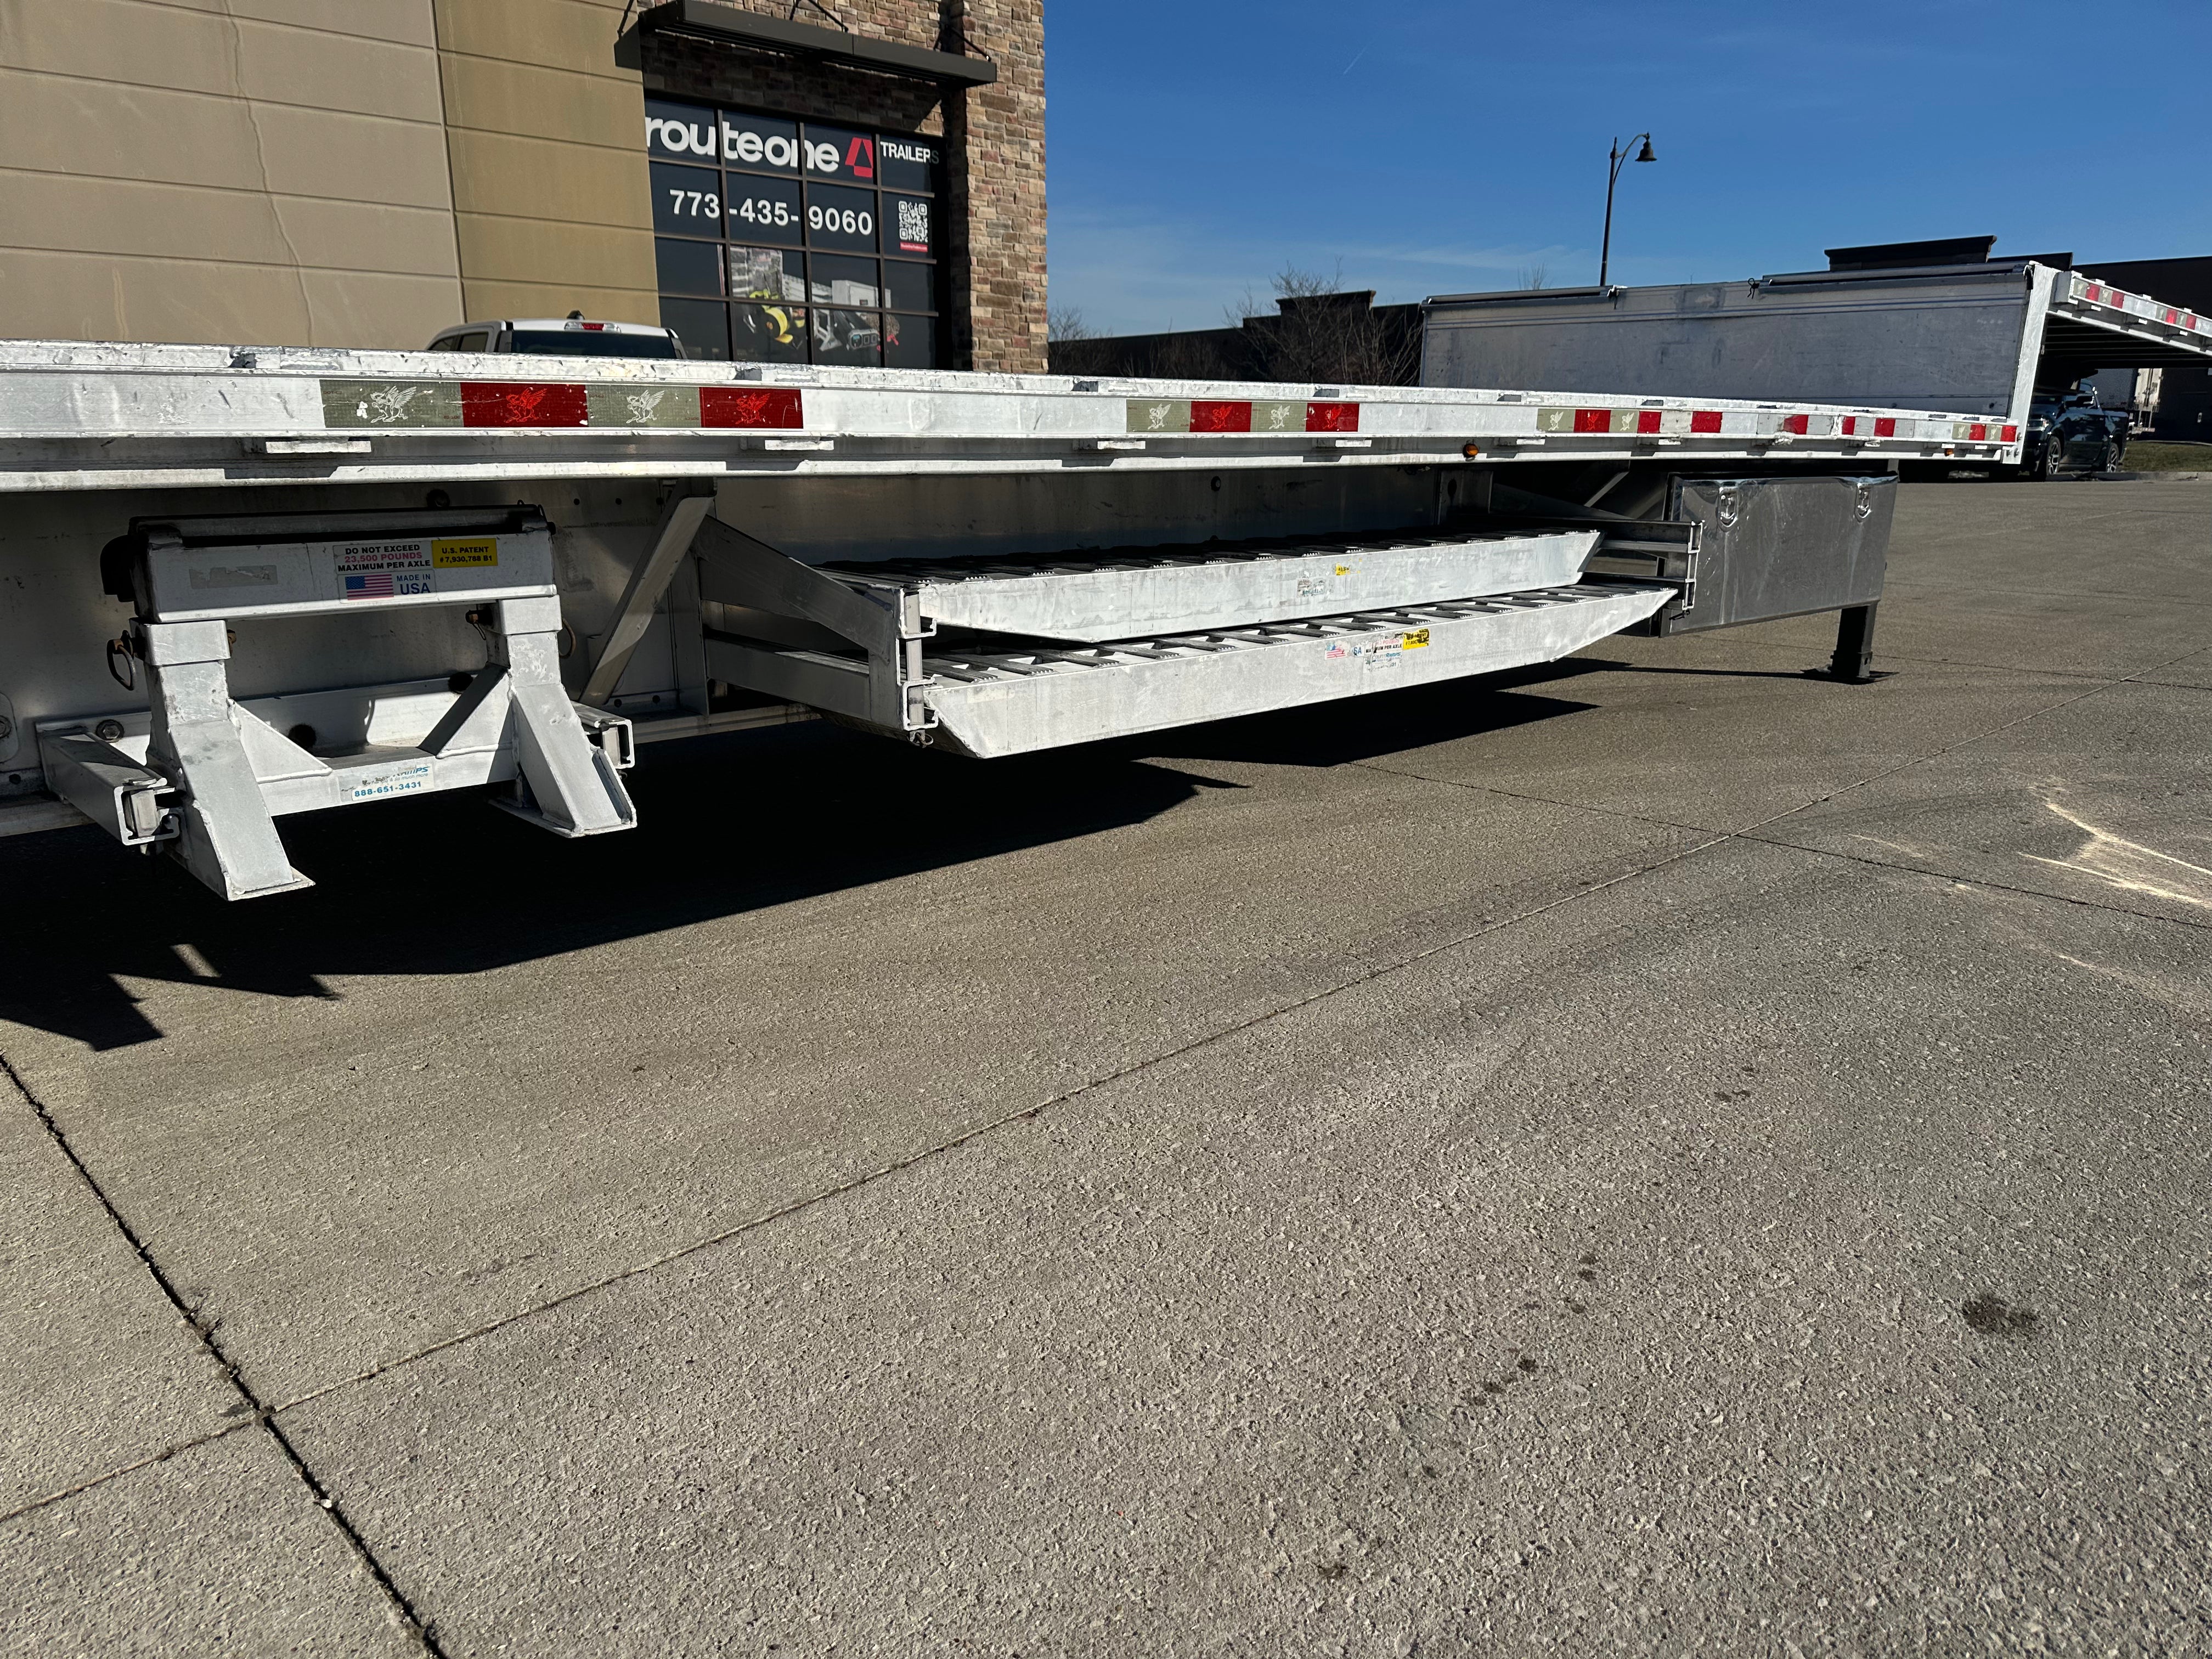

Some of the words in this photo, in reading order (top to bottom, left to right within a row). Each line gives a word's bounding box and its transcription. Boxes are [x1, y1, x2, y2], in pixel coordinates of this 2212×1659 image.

[645, 116, 840, 173] routeone
[880, 141, 940, 165] TRAILERS
[384, 544, 420, 552] EXCEED
[345, 555, 378, 563] 23,500
[381, 552, 422, 561] POUNDS
[338, 562, 384, 572] MAXIMUM
[387, 561, 405, 569] PER
[408, 560, 431, 568] AXLE
[400, 583, 431, 595] USA
[354, 781, 421, 797] 888-651-3431
